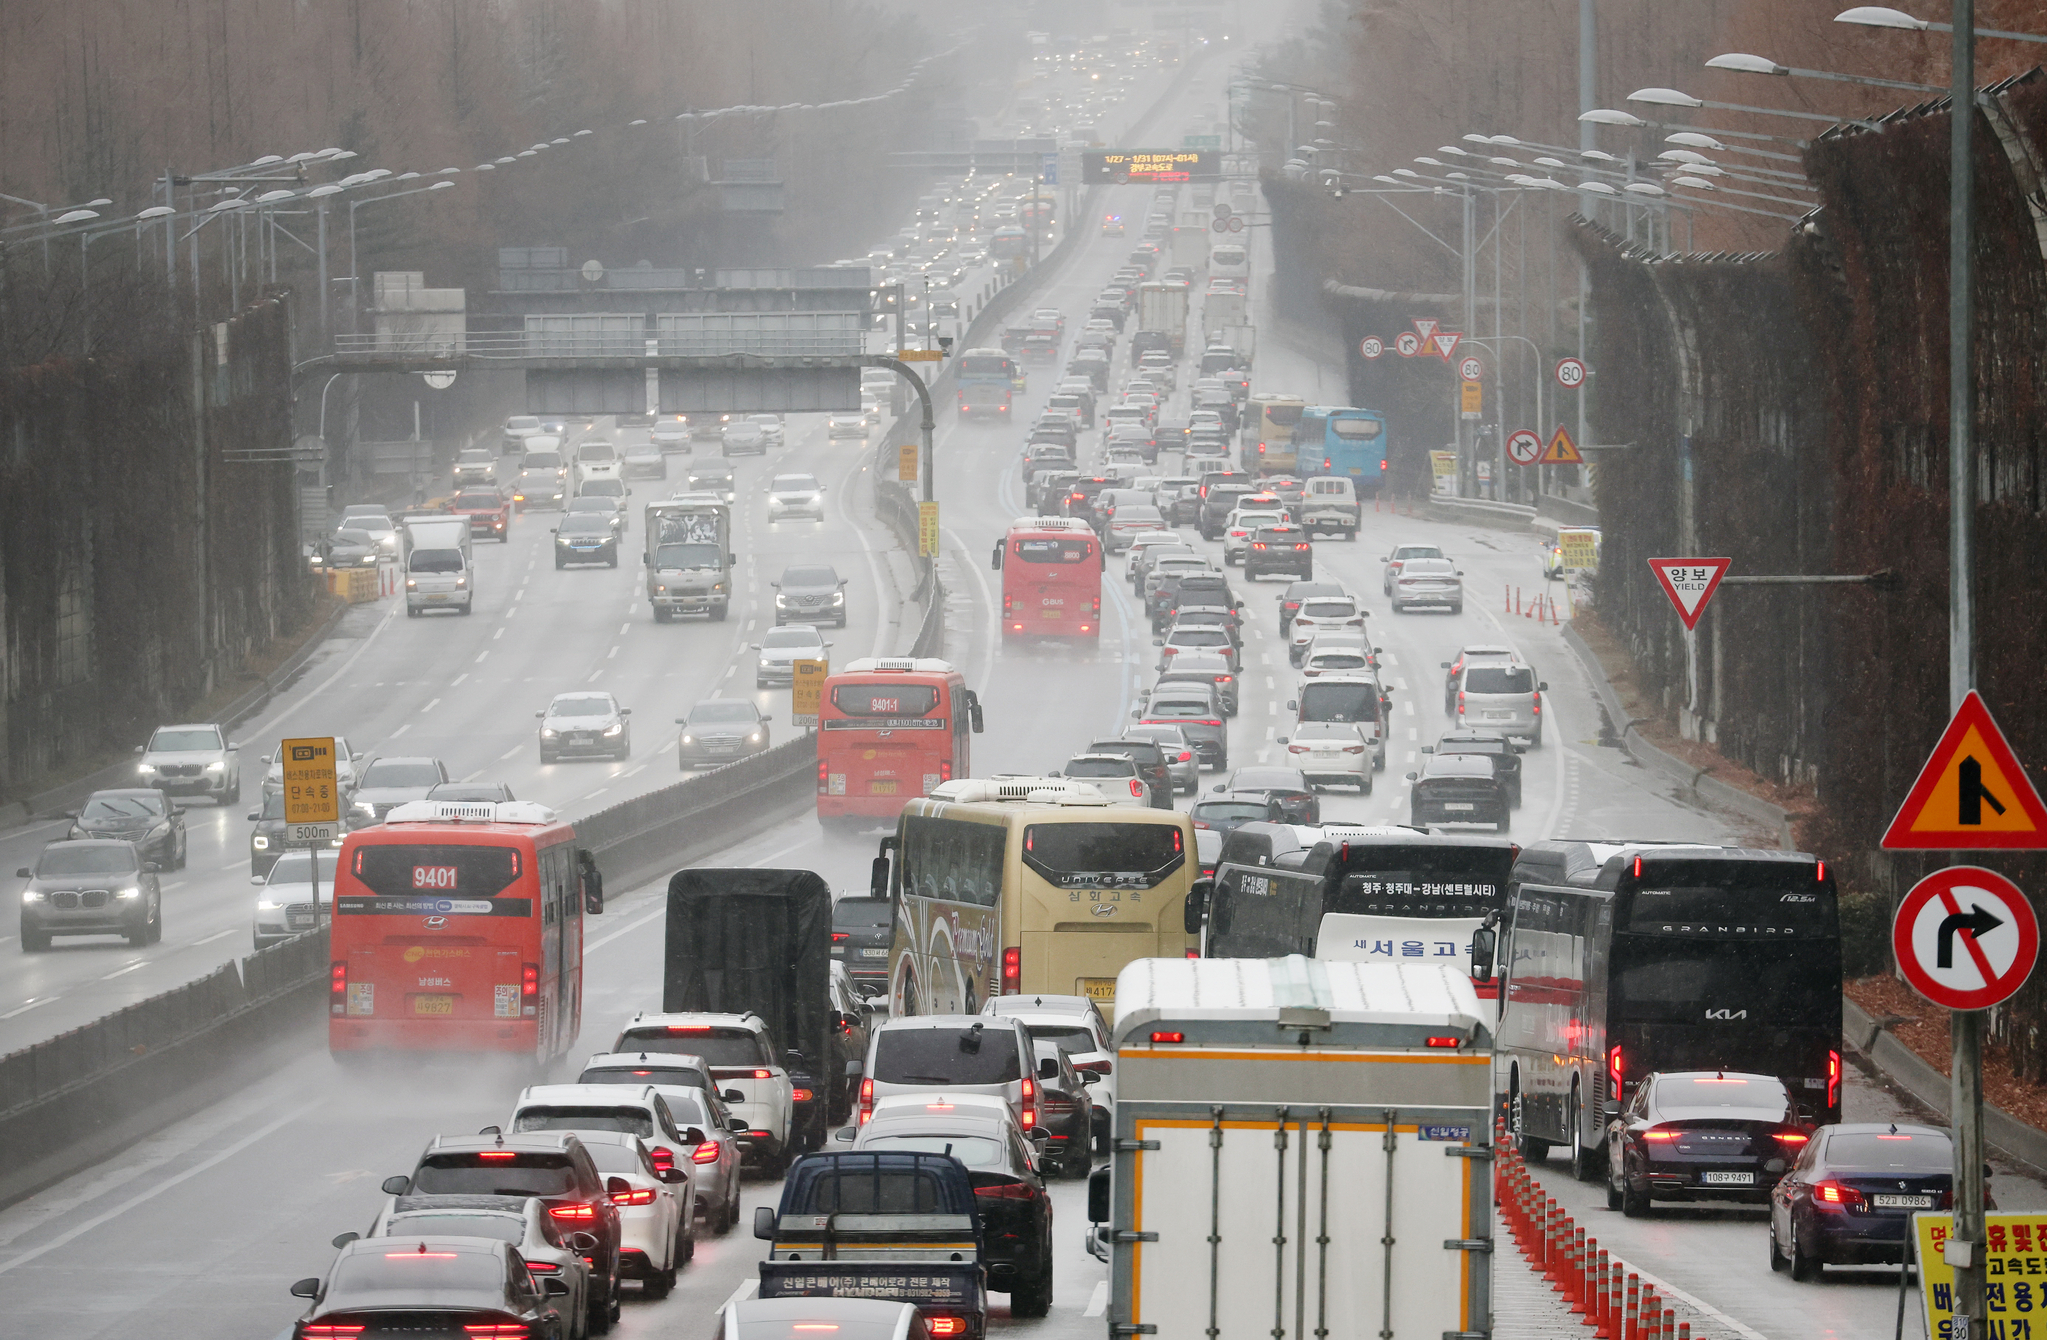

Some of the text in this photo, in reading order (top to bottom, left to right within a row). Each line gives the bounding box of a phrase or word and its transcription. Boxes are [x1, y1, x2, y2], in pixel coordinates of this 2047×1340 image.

[1132, 154, 1151, 163] 1/31
[1365, 342, 1380, 354] 80
[1465, 364, 1480, 376] 80
[1562, 366, 1580, 381] 80
[1671, 568, 1708, 582] 양보
[296, 826, 329, 839] 500m
[415, 867, 456, 887] 9401
[1662, 925, 1794, 934] GRANBIRD
[1353, 939, 1367, 949] 새
[419, 977, 451, 987] 남성버스
[424, 1003, 450, 1012] 9827
[1731, 1173, 1751, 1182] 9491
[1901, 1196, 1926, 1206] 0986
[909, 1277, 928, 1287] 전문
[931, 1277, 951, 1287] 제작
[1954, 1327, 1967, 1339] 30
